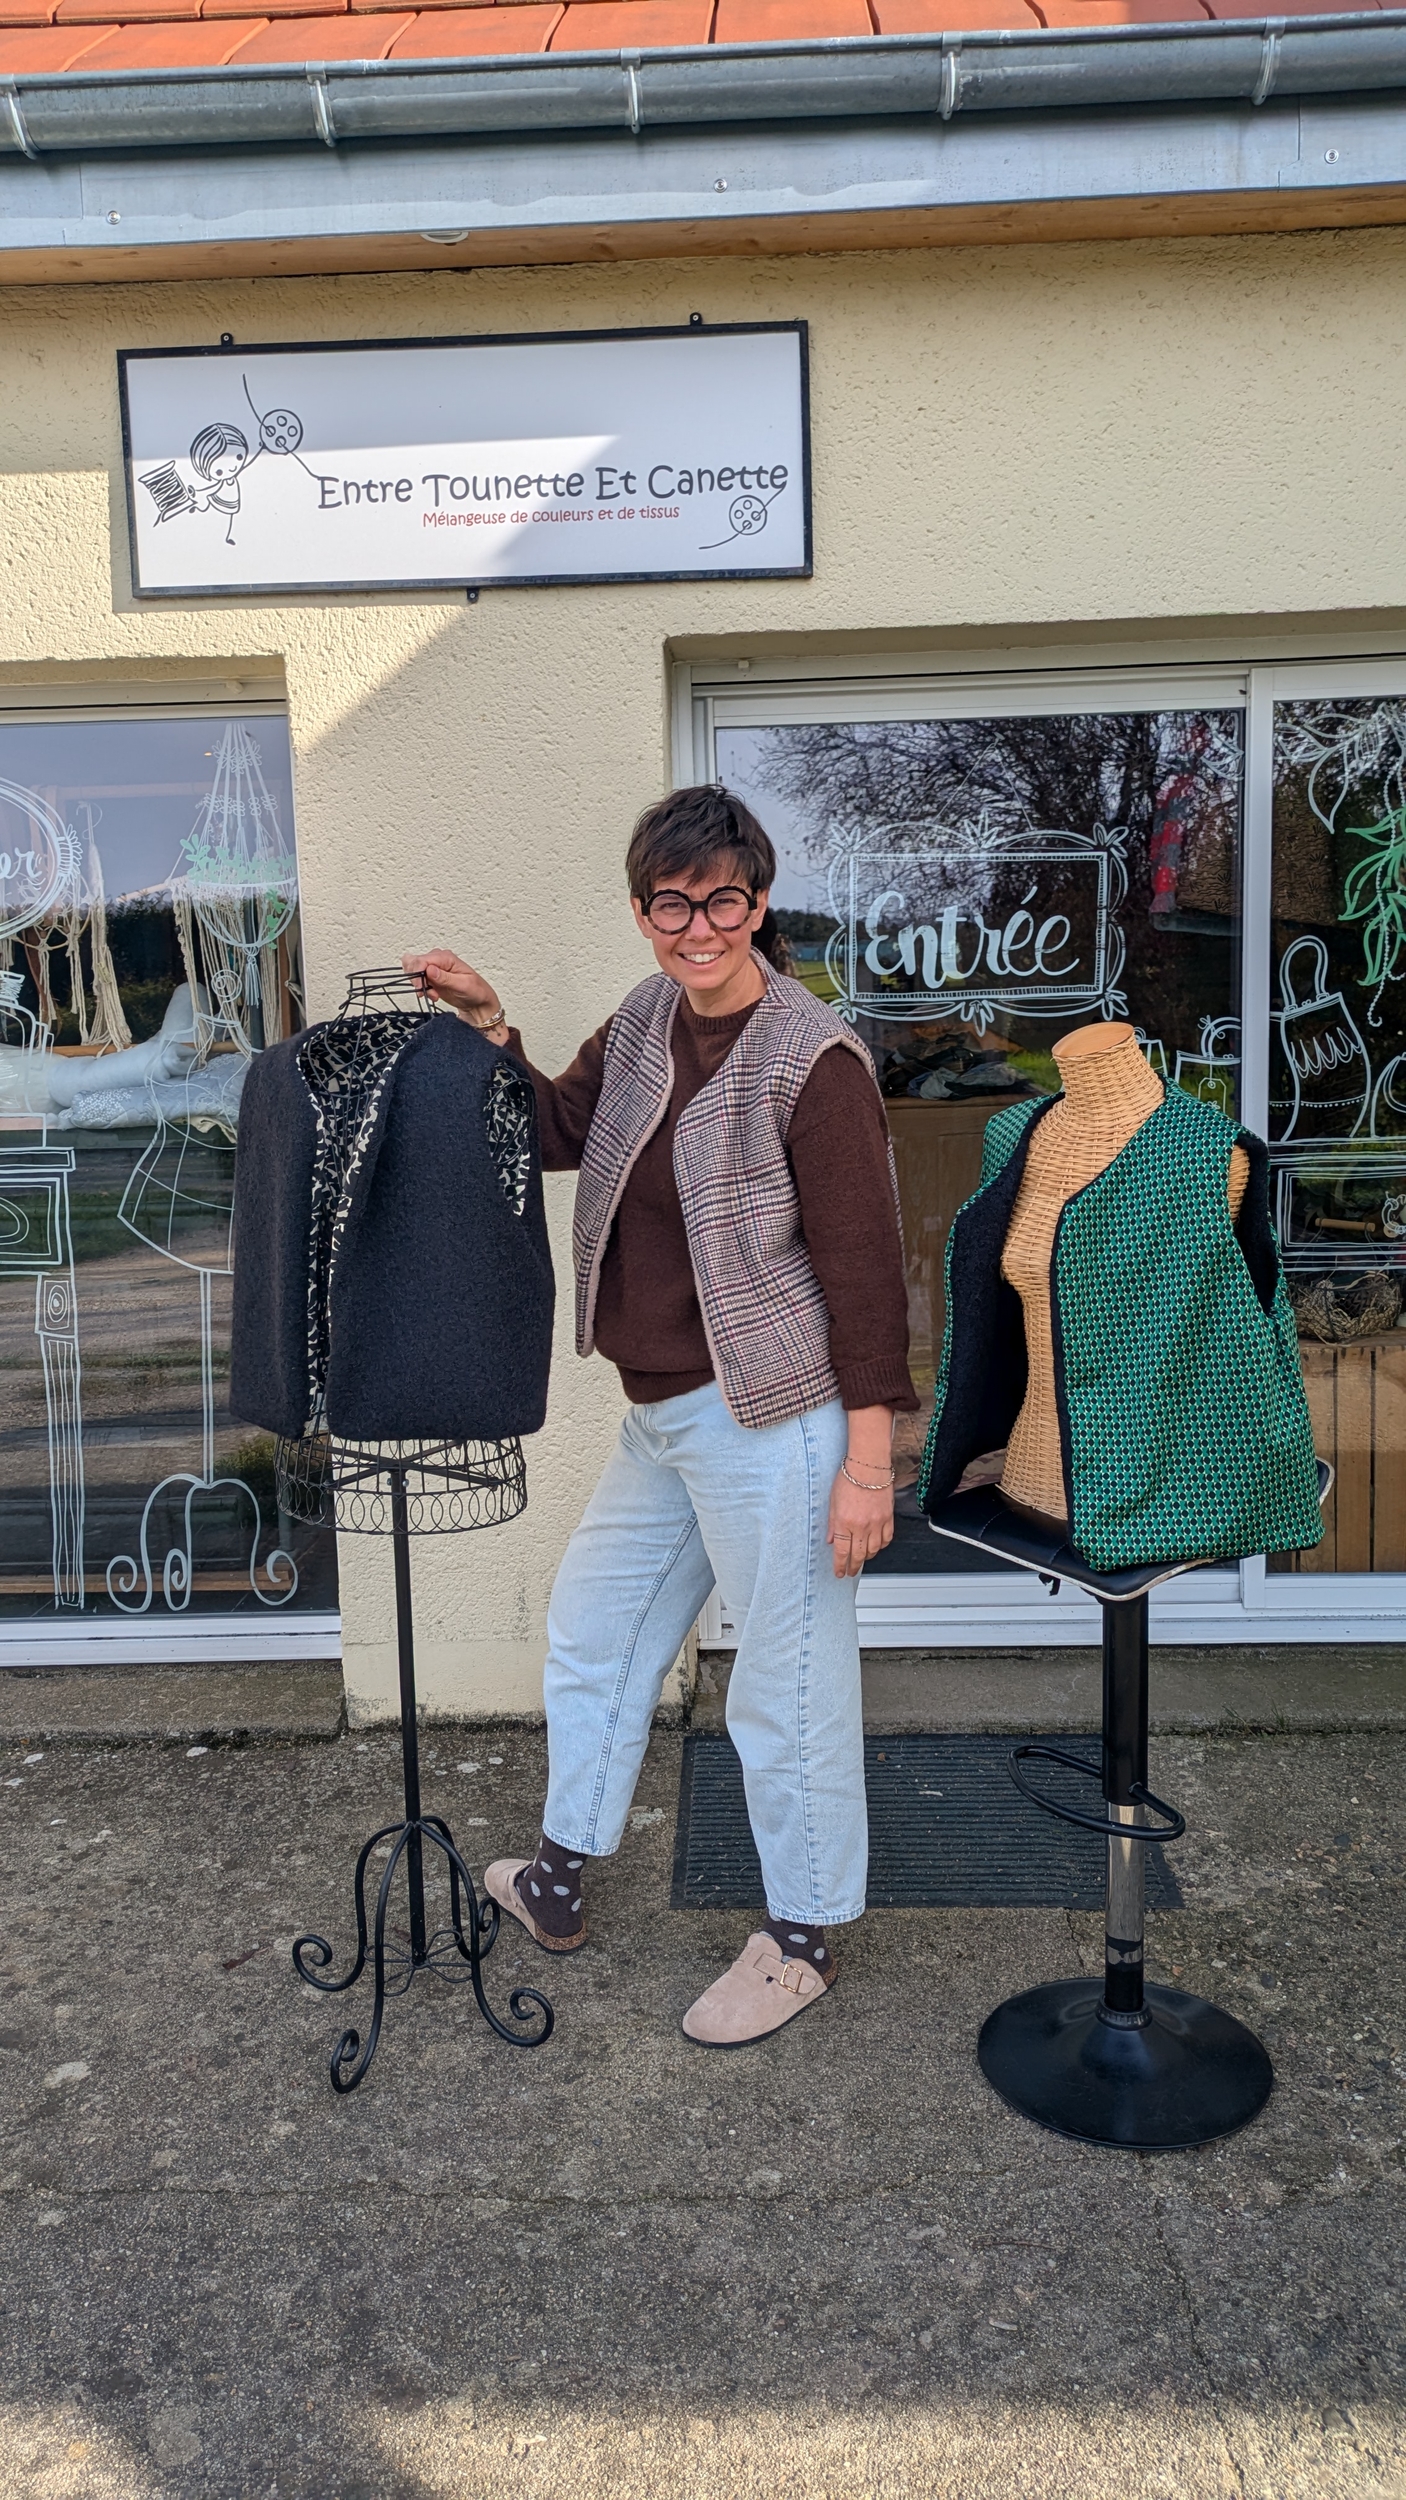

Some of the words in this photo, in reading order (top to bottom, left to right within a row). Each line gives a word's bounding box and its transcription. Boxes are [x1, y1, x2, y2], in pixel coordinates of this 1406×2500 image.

[317, 475, 414, 509] Entre
[421, 473, 584, 507] Tounette
[595, 466, 637, 500] Et
[647, 464, 788, 499] Canette
[423, 510, 506, 528] Mélangeuse
[510, 510, 528, 523] de
[532, 508, 594, 523] couleurs
[598, 507, 614, 520] et
[617, 507, 635, 520] de
[639, 505, 680, 519] tissus
[864, 886, 1081, 989] Entrée
